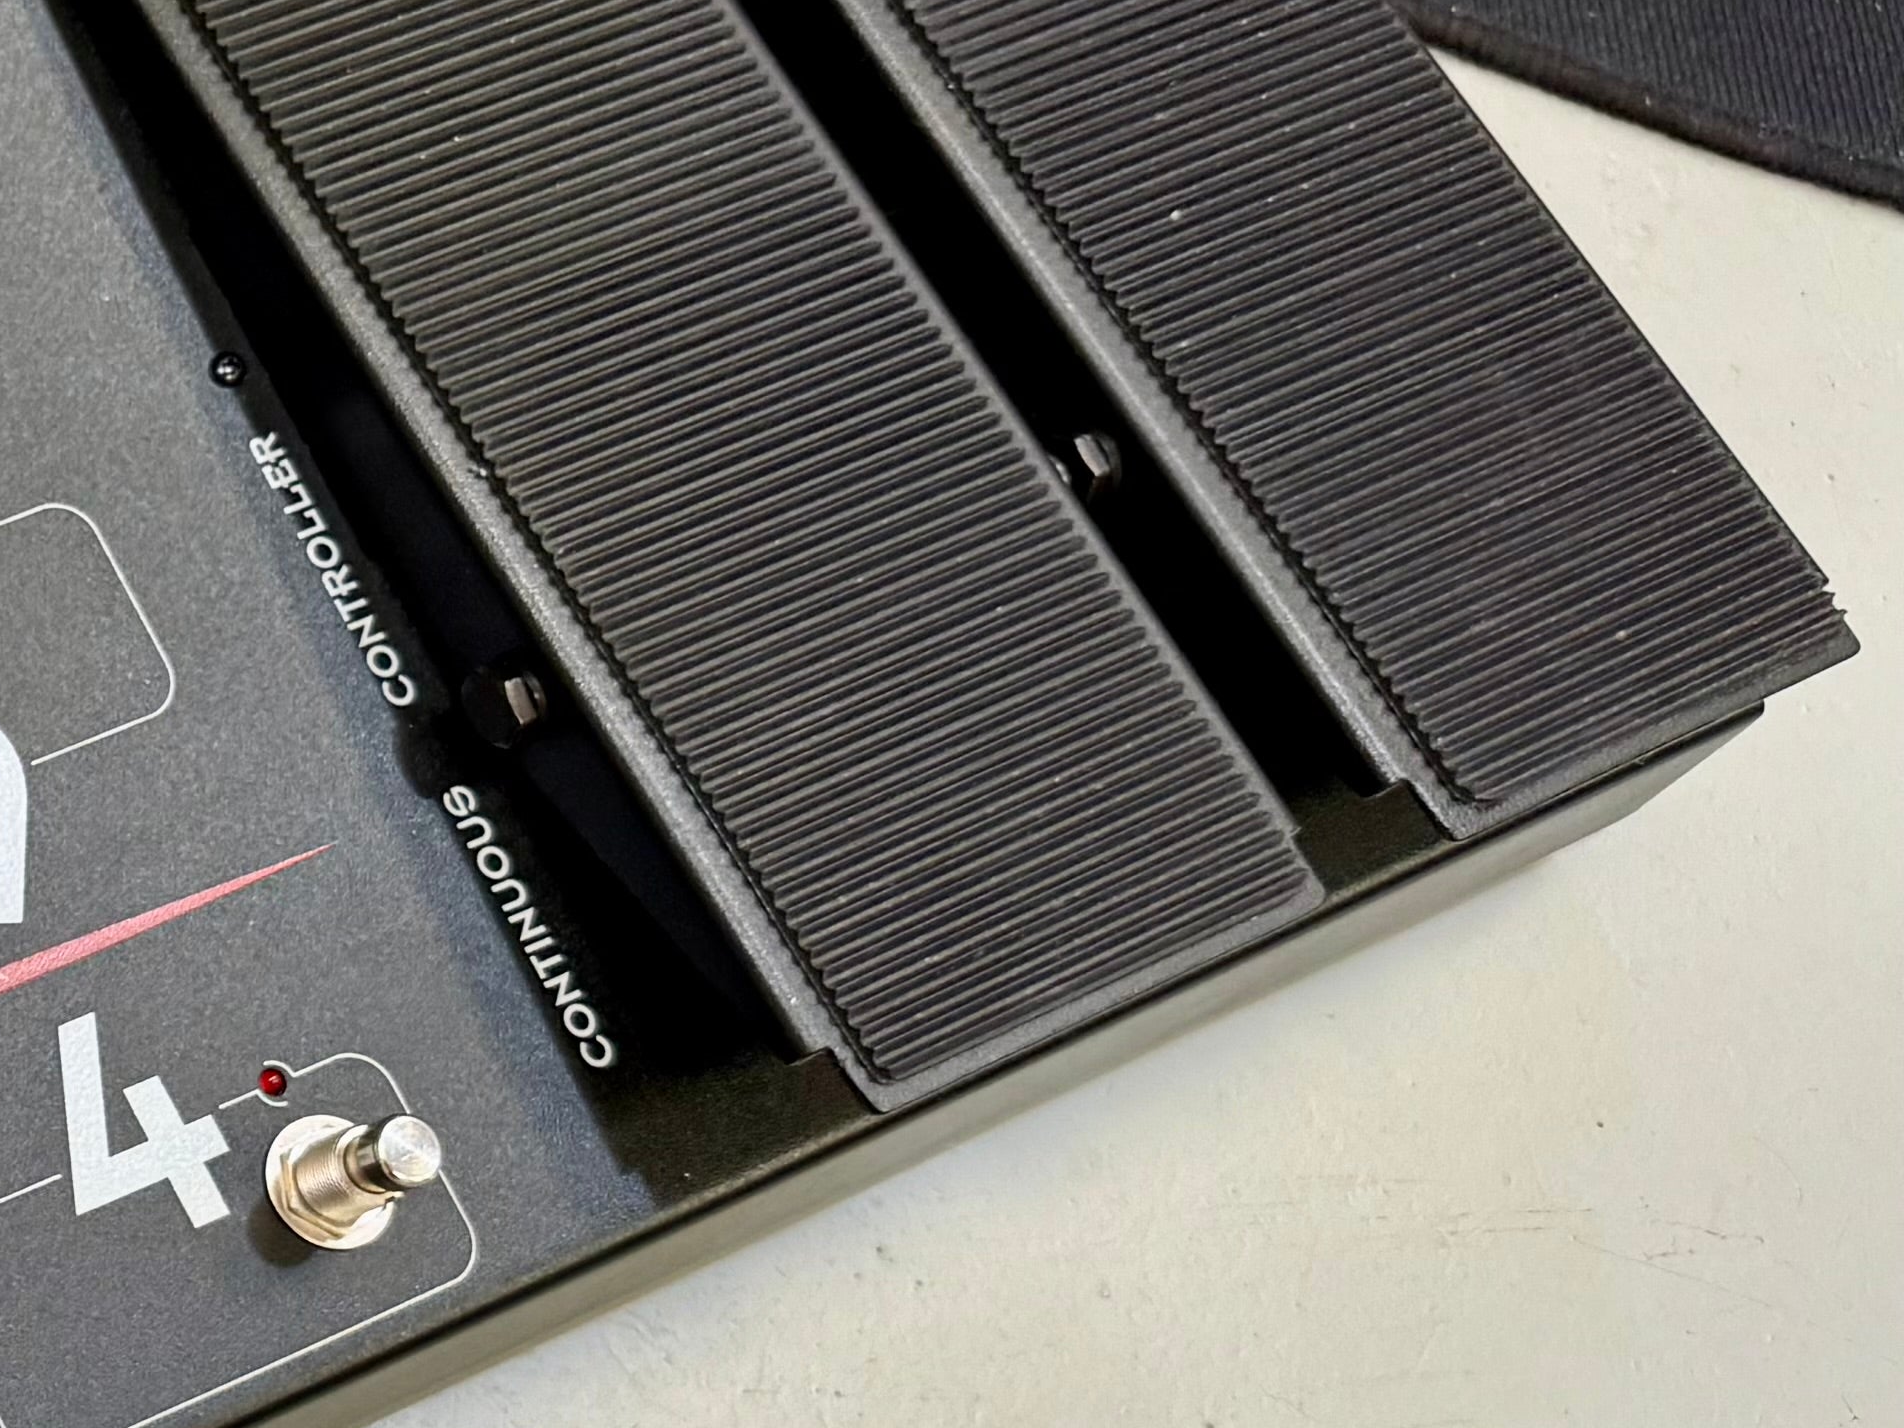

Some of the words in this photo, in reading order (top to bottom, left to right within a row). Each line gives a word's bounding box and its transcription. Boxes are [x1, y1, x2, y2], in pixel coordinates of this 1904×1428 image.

[248, 431, 416, 707] CONTROLLER
[442, 784, 614, 1069] CONTINUOUS
[57, 1011, 232, 1229] 4
